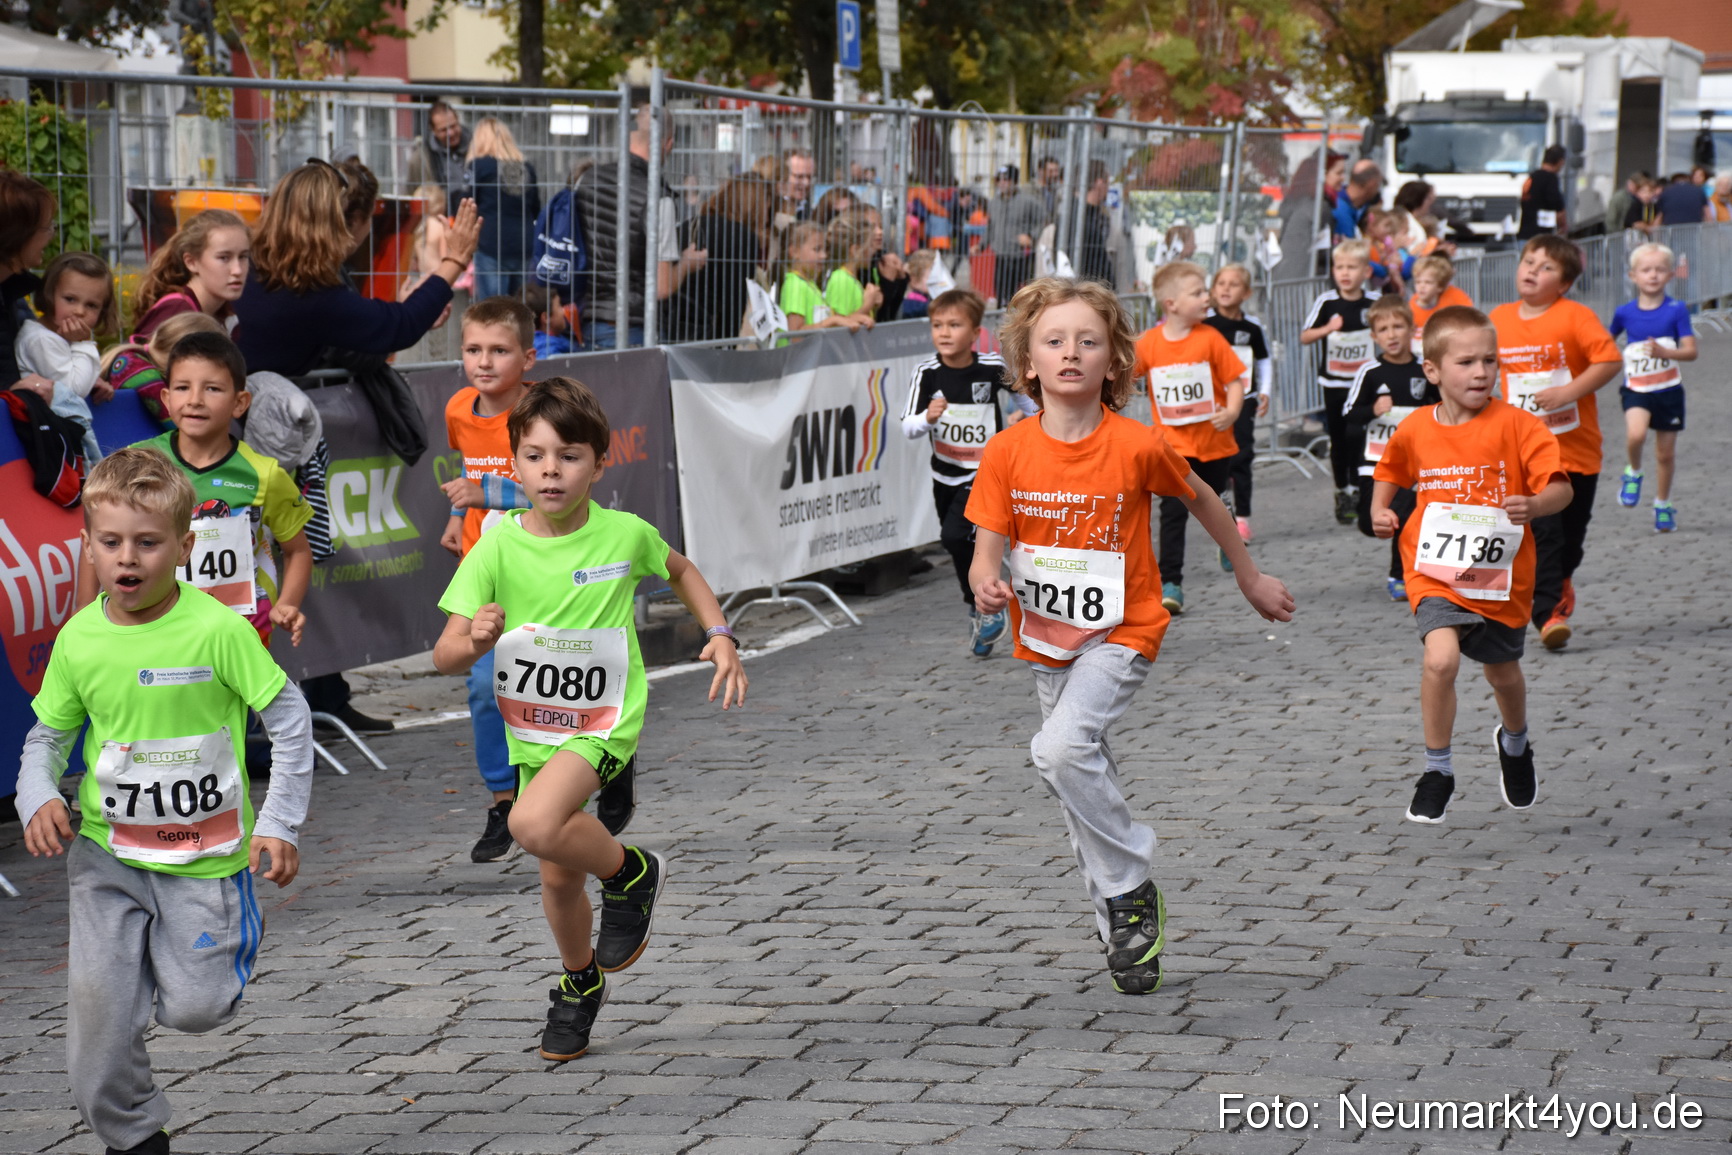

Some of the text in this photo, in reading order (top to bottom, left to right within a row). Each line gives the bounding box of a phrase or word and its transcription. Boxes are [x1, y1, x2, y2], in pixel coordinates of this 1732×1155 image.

[841, 9, 855, 59] P
[1334, 344, 1368, 359] 7097
[1161, 382, 1204, 403] 7190
[1518, 393, 1540, 412] 73
[940, 422, 986, 443] 7063
[1376, 423, 1398, 440] 70
[780, 404, 856, 490] swn
[329, 464, 407, 539] CK
[1435, 532, 1506, 564] 7136
[185, 549, 237, 582] 140
[1046, 557, 1088, 571] BOCK
[1024, 579, 1104, 622] 7218
[547, 638, 592, 650] BOCK
[515, 658, 606, 701] 7080
[523, 708, 590, 729] LEOPOLD
[148, 749, 200, 763] BOCK
[116, 773, 223, 817] 7108
[106, 811, 116, 819] B4
[157, 830, 201, 843] Georg
